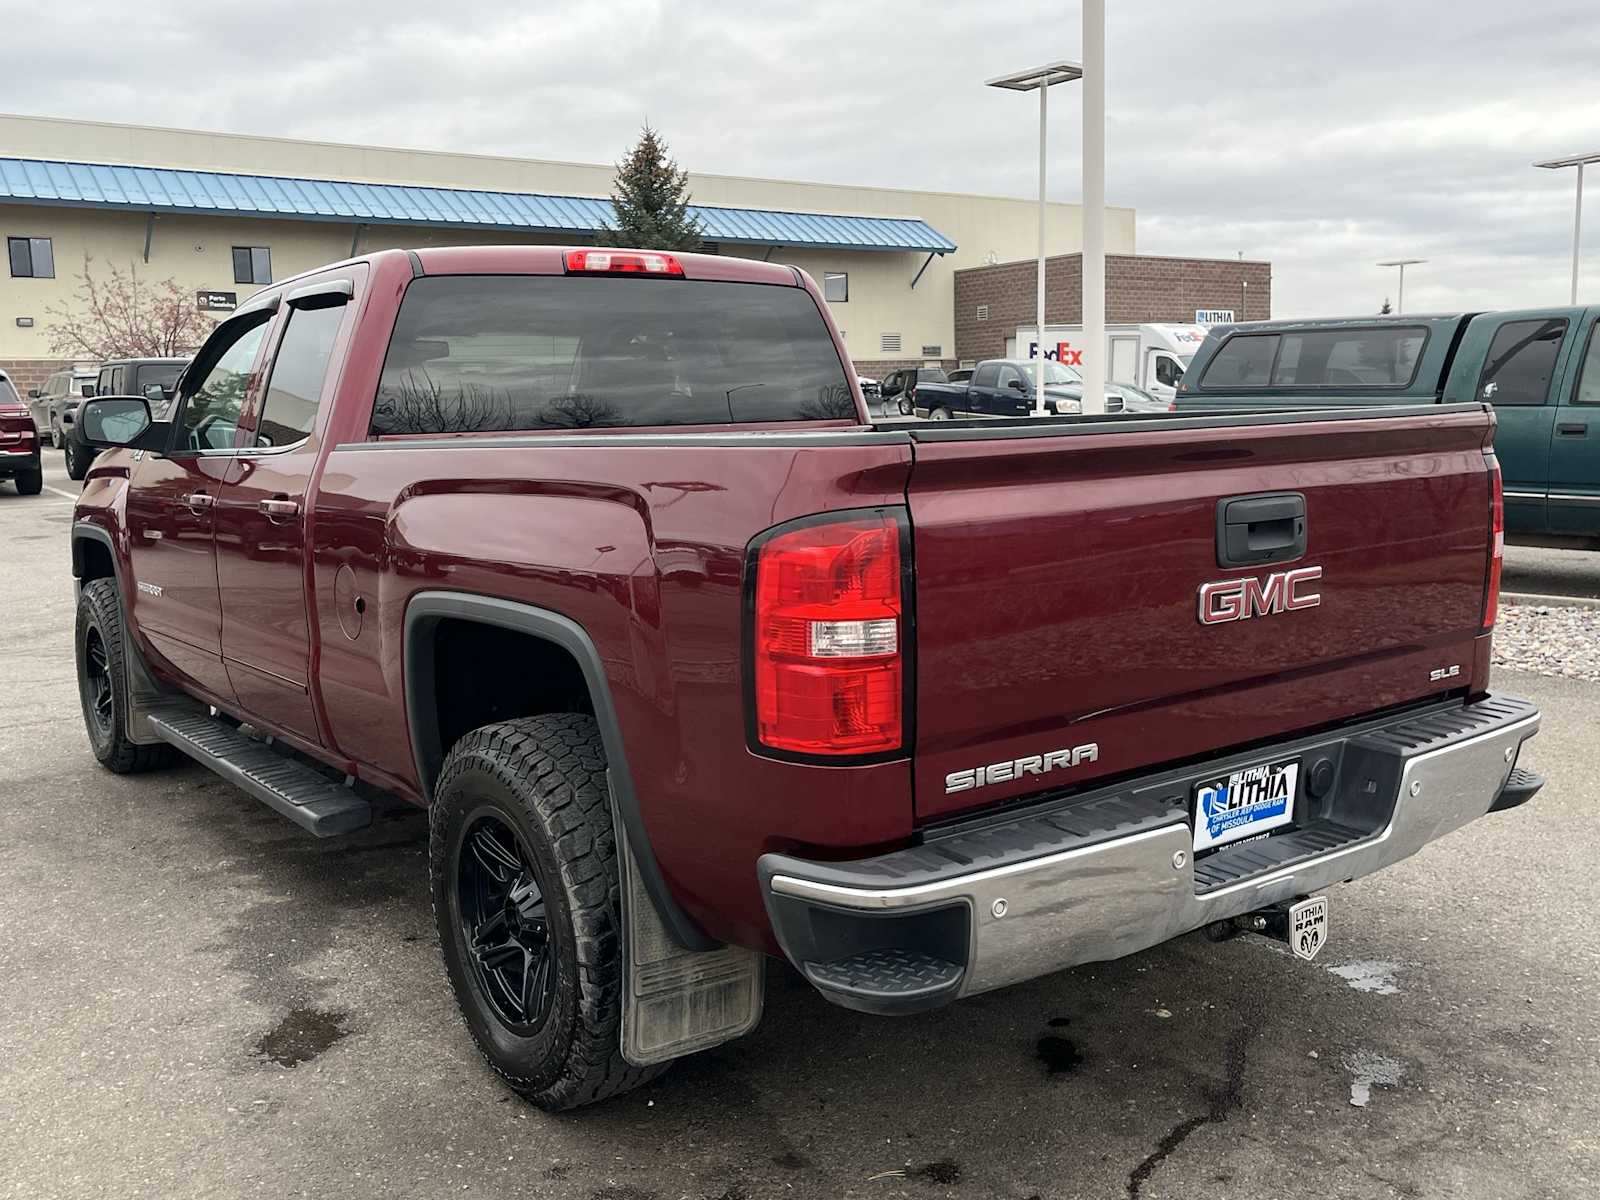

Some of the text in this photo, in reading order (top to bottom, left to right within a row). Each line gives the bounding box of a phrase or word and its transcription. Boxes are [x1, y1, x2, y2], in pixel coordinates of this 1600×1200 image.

[1205, 311, 1232, 323] LITHIA
[1198, 565, 1322, 625] GMC
[1430, 664, 1460, 682] SLE
[945, 742, 1099, 794] SIERRA
[1240, 766, 1269, 783] LITHIA
[1228, 774, 1288, 809] LITHIA
[1211, 814, 1254, 833] OF MISSOULA
[1295, 905, 1323, 922] LITHIA
[1295, 915, 1323, 931] RAM
